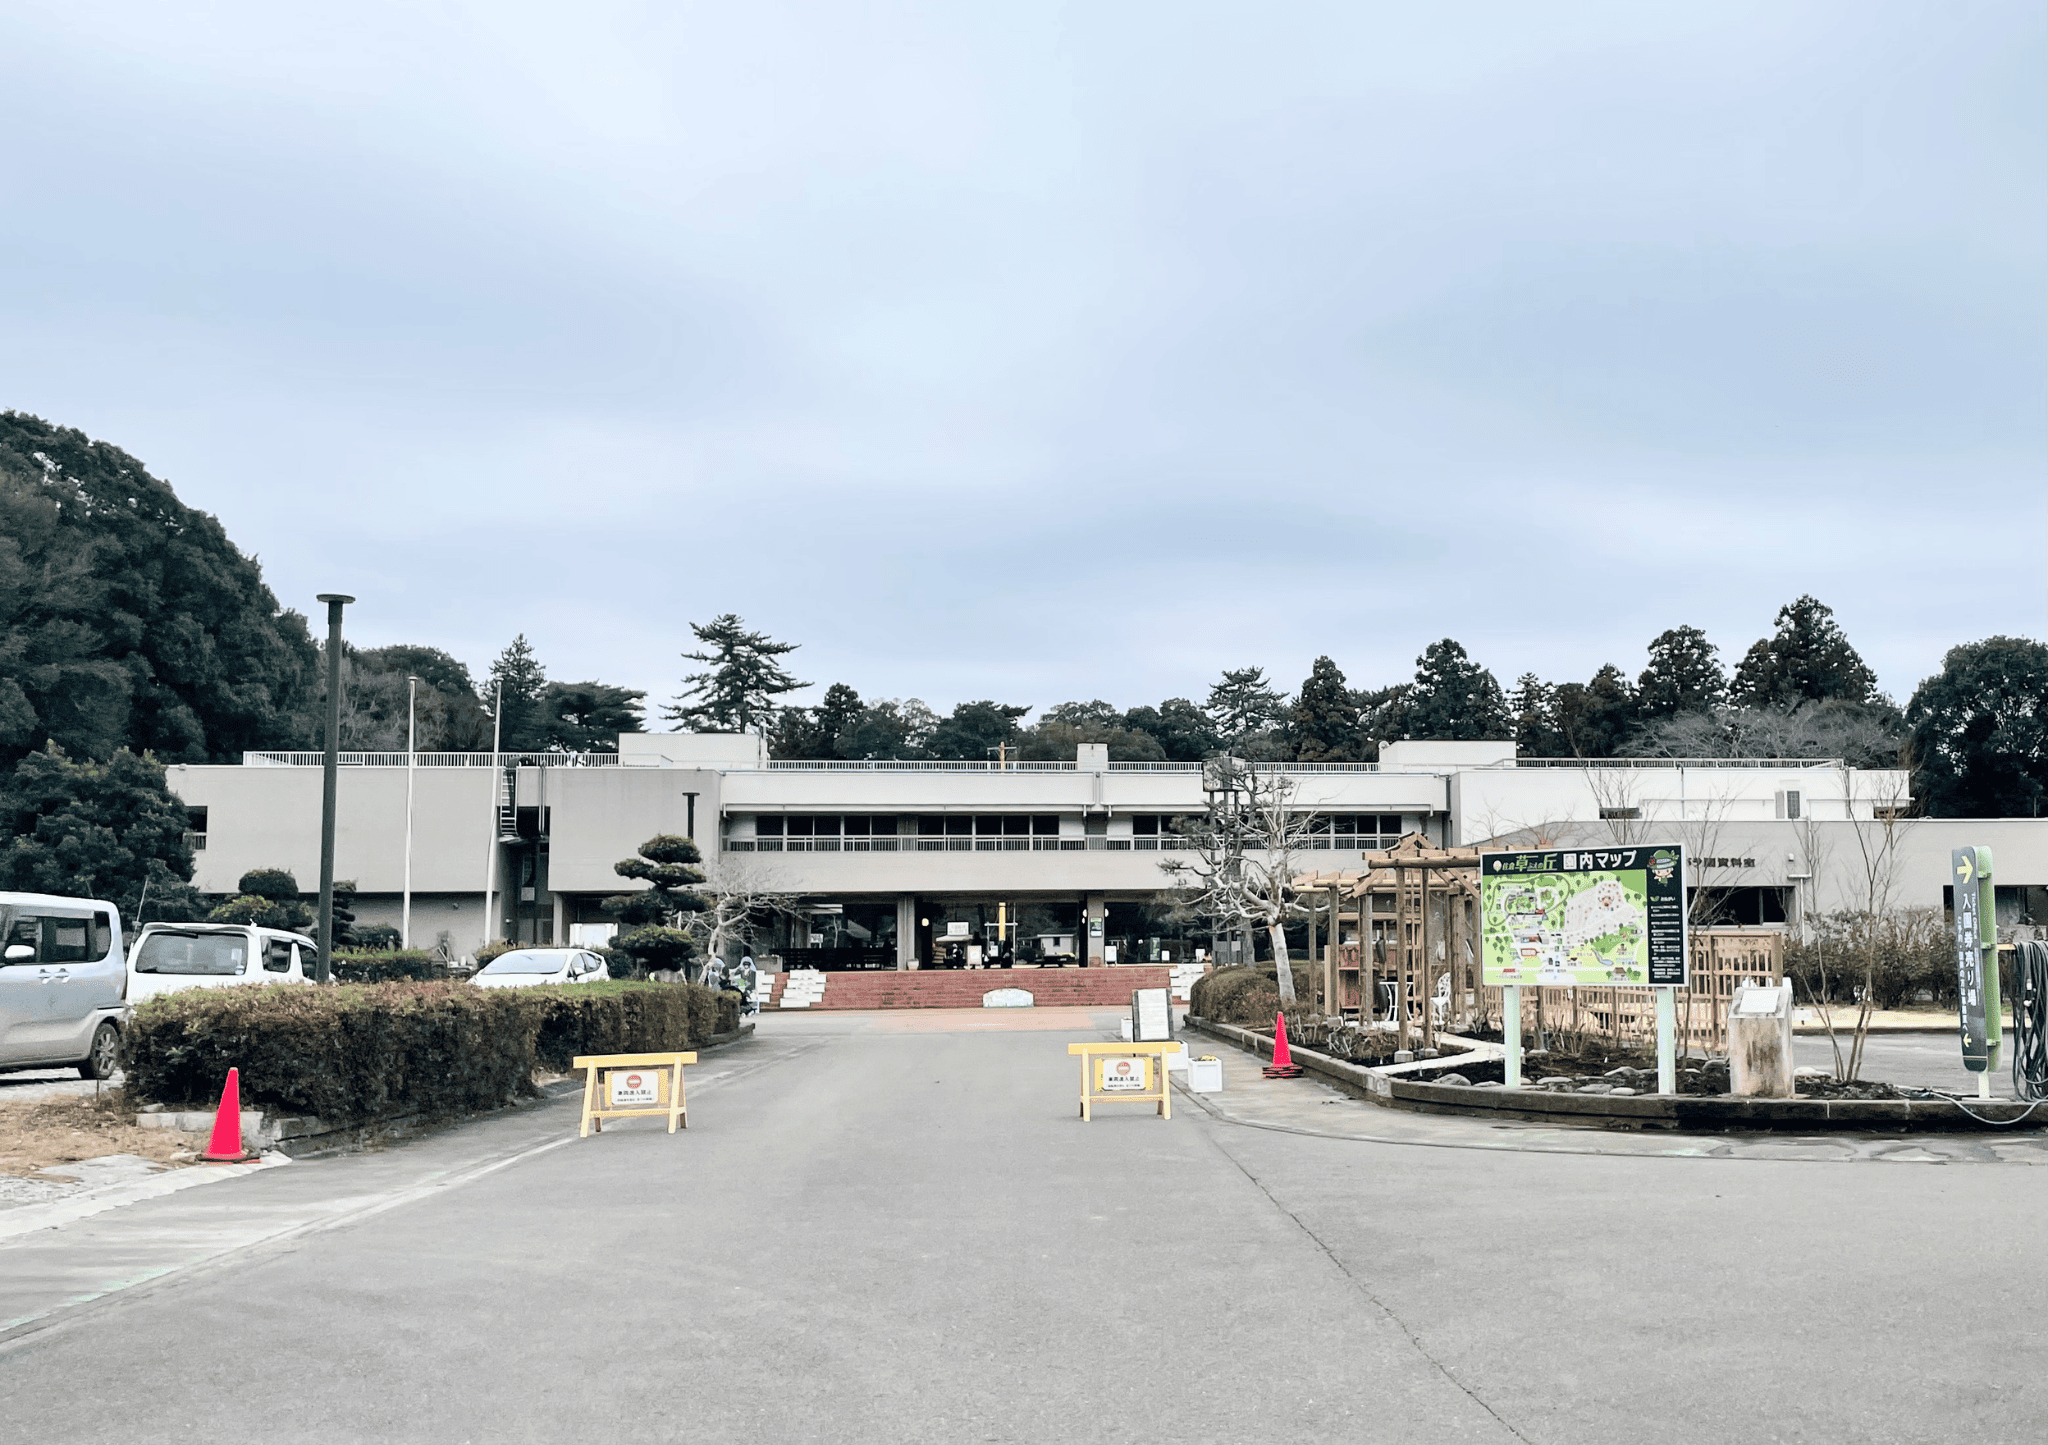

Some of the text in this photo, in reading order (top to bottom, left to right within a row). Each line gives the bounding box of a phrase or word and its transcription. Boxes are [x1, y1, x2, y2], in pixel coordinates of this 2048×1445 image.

[1563, 850, 1637, 870] 園内マップ
[1962, 893, 1977, 1006] 入園券売り場
